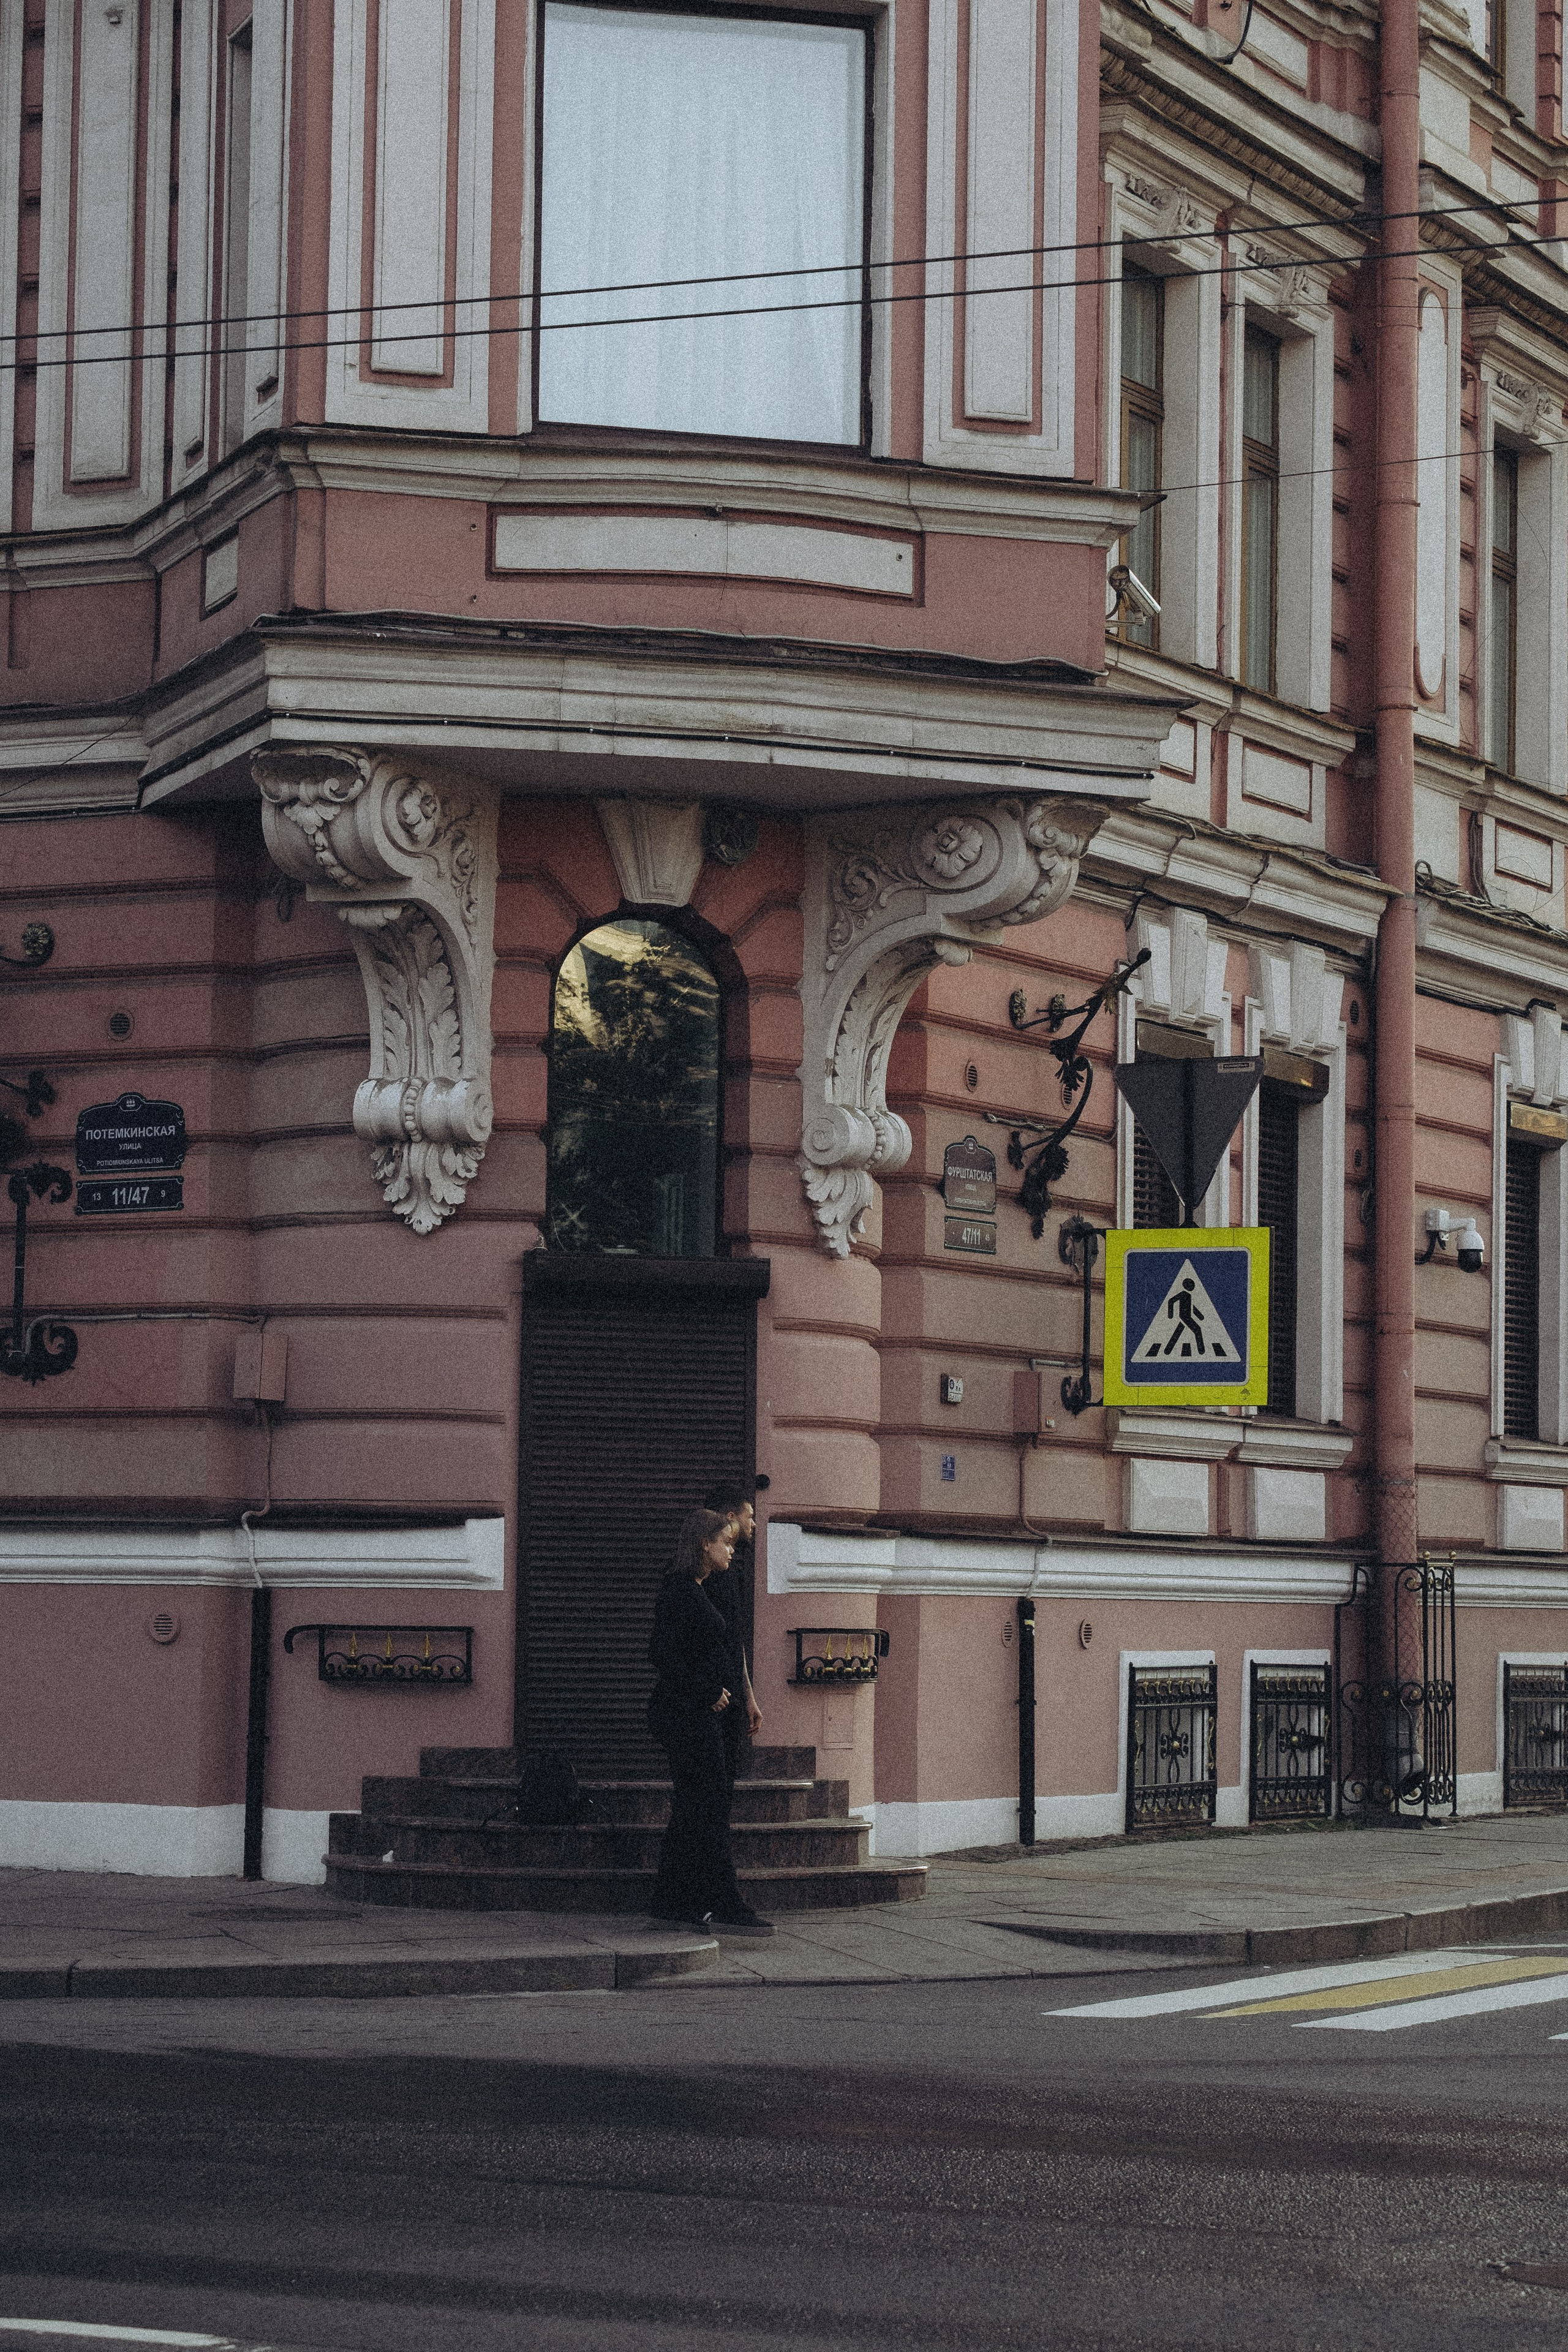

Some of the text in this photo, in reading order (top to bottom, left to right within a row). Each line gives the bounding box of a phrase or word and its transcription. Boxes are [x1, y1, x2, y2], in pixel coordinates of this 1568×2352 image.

[85, 1125, 175, 1140] ПОТЕМКИНСКАЯ
[948, 1166, 992, 1183] ФУРШТАТСКАЯ
[111, 1186, 149, 1205] 11/47
[962, 1227, 981, 1245] 47/11
